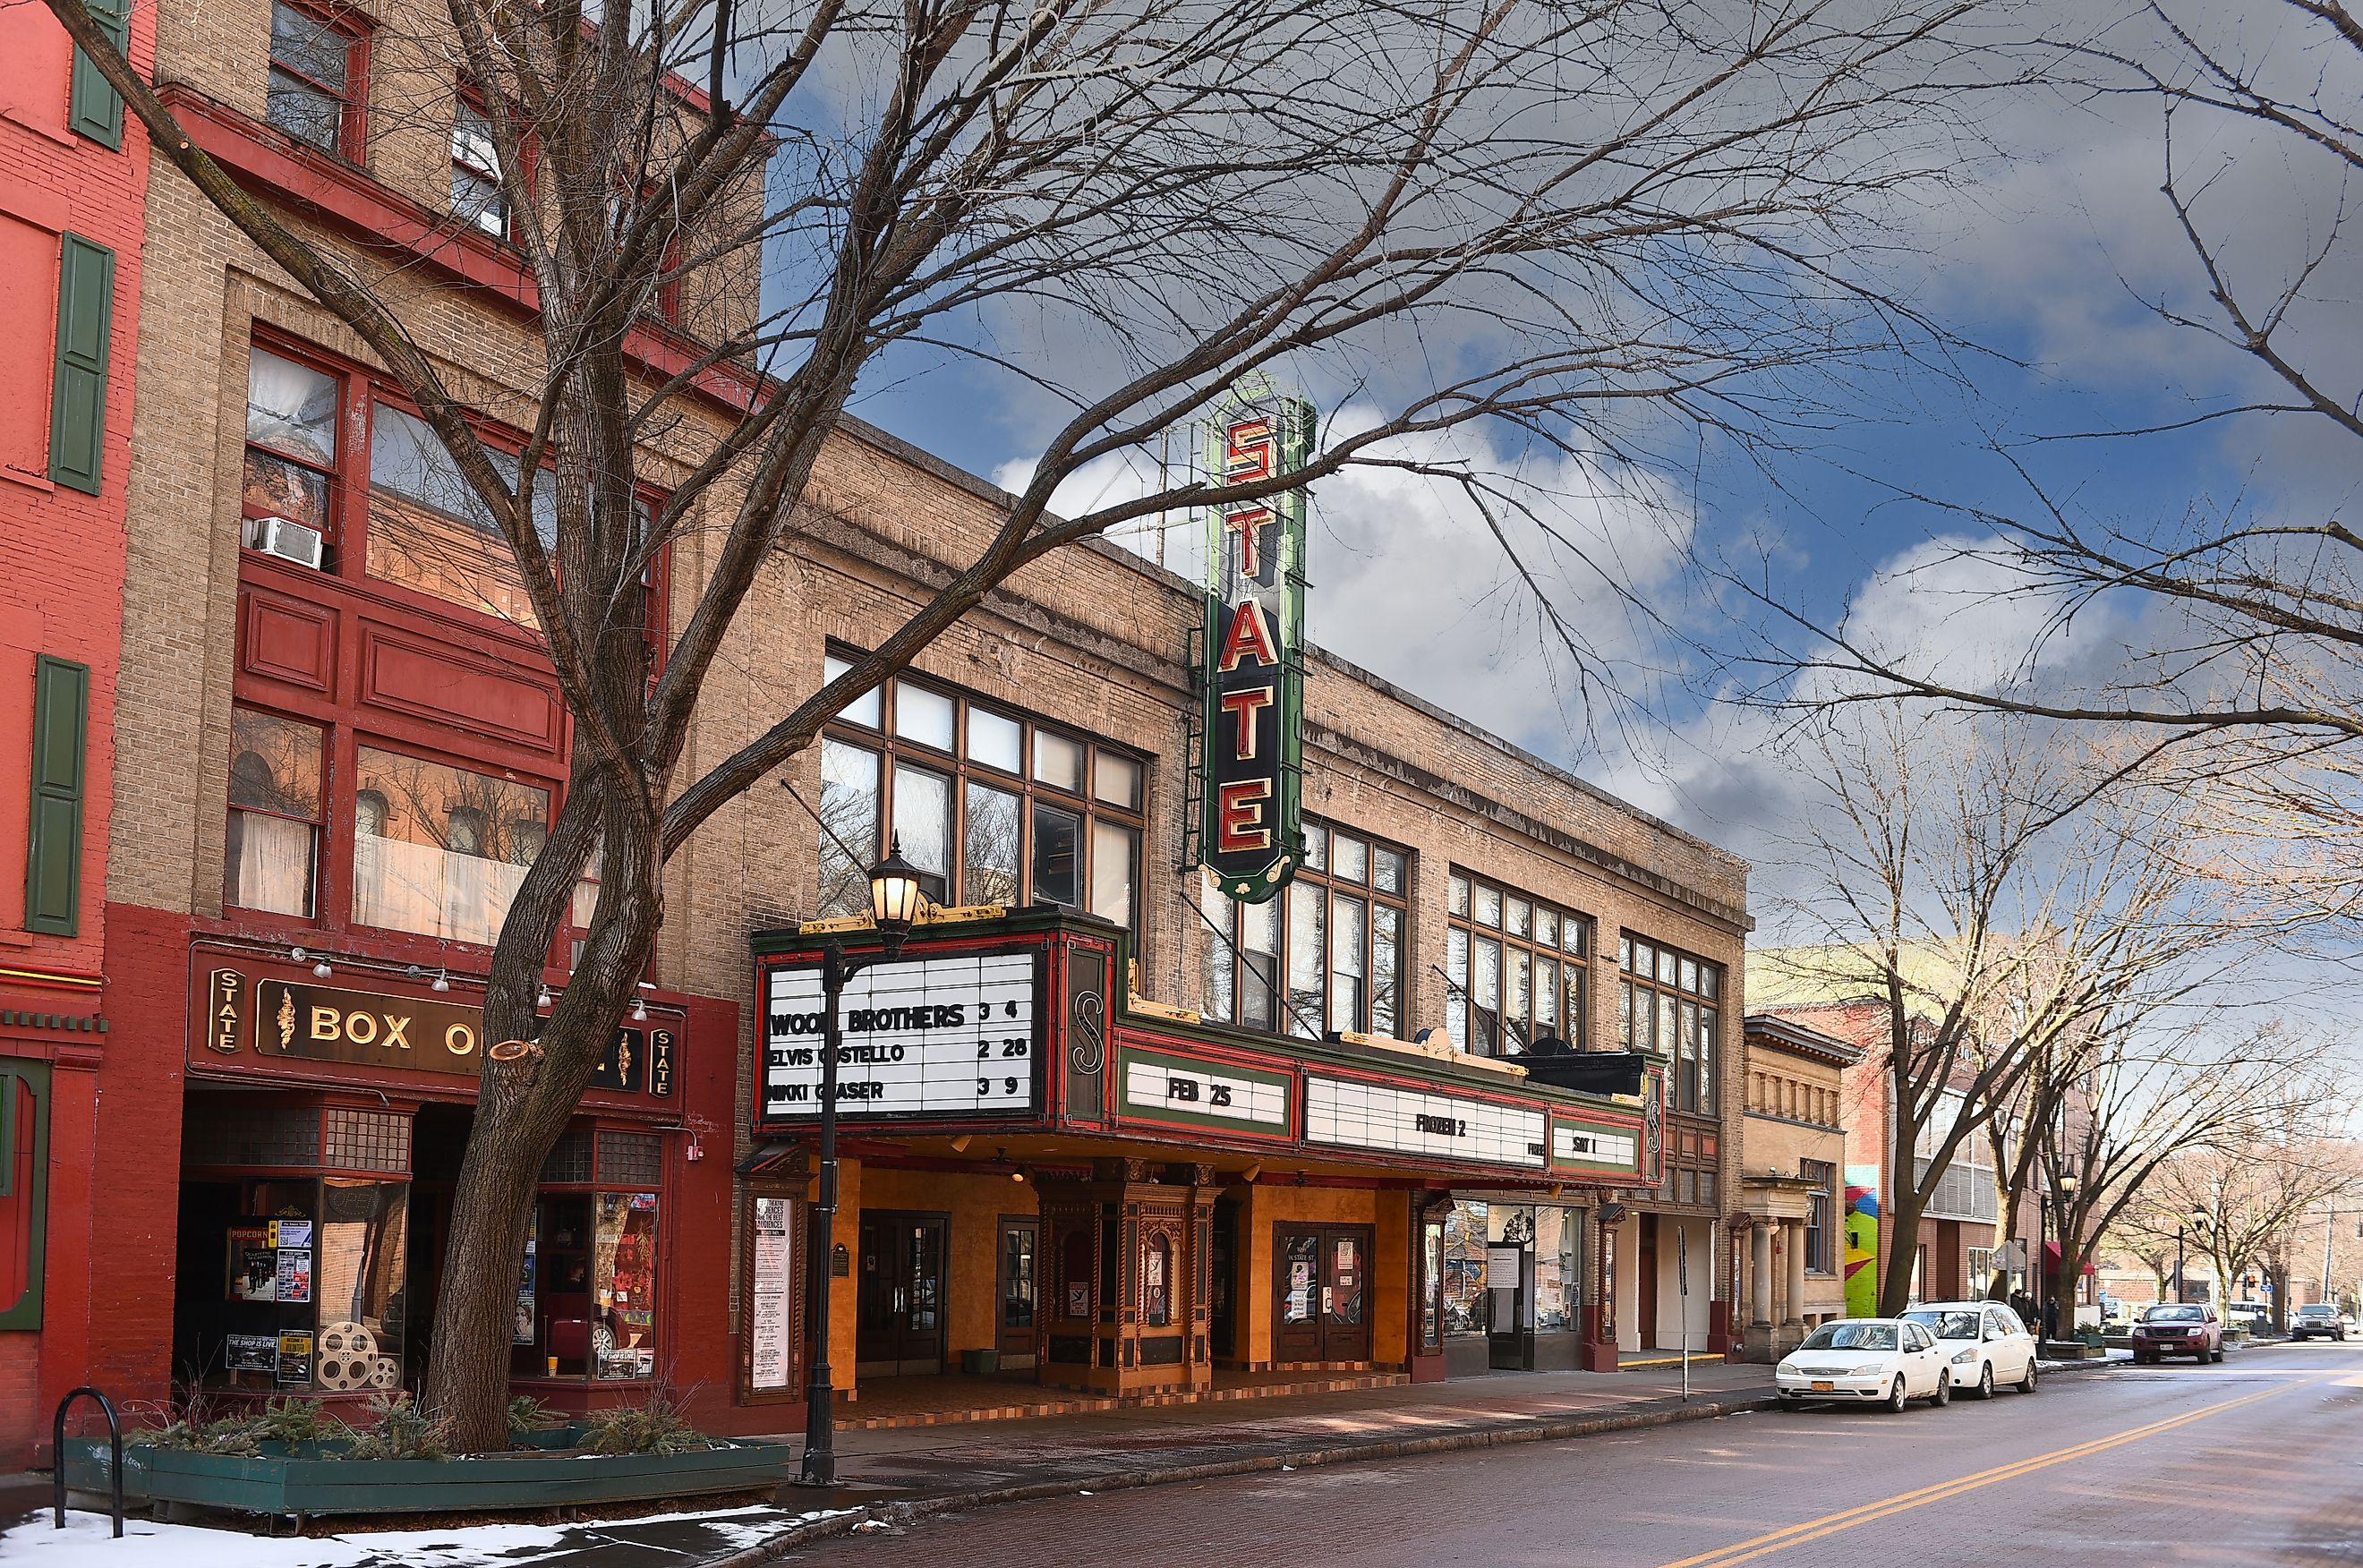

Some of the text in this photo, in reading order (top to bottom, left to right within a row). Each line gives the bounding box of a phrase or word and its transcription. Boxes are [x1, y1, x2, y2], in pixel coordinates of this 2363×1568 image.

[1216, 416, 1280, 854] STATE
[218, 972, 238, 1049] STATE
[770, 1000, 1017, 1035] WOO BROTHERS 3 4
[310, 1005, 412, 1049] BOX
[657, 1033, 669, 1094] STATE
[770, 1048, 813, 1066] ELVIS
[978, 1040, 989, 1057] 2
[1002, 1038, 1027, 1056] 28
[770, 1077, 1018, 1101] NIKKI GASER 3 9
[1169, 1077, 1232, 1107] FEB 25
[1416, 1113, 1466, 1138] FROZEN 2
[1573, 1136, 1590, 1153] SAT
[333, 1191, 381, 1209] OPEN
[232, 1231, 269, 1239] POPCORN
[239, 1339, 255, 1347] SHOP
